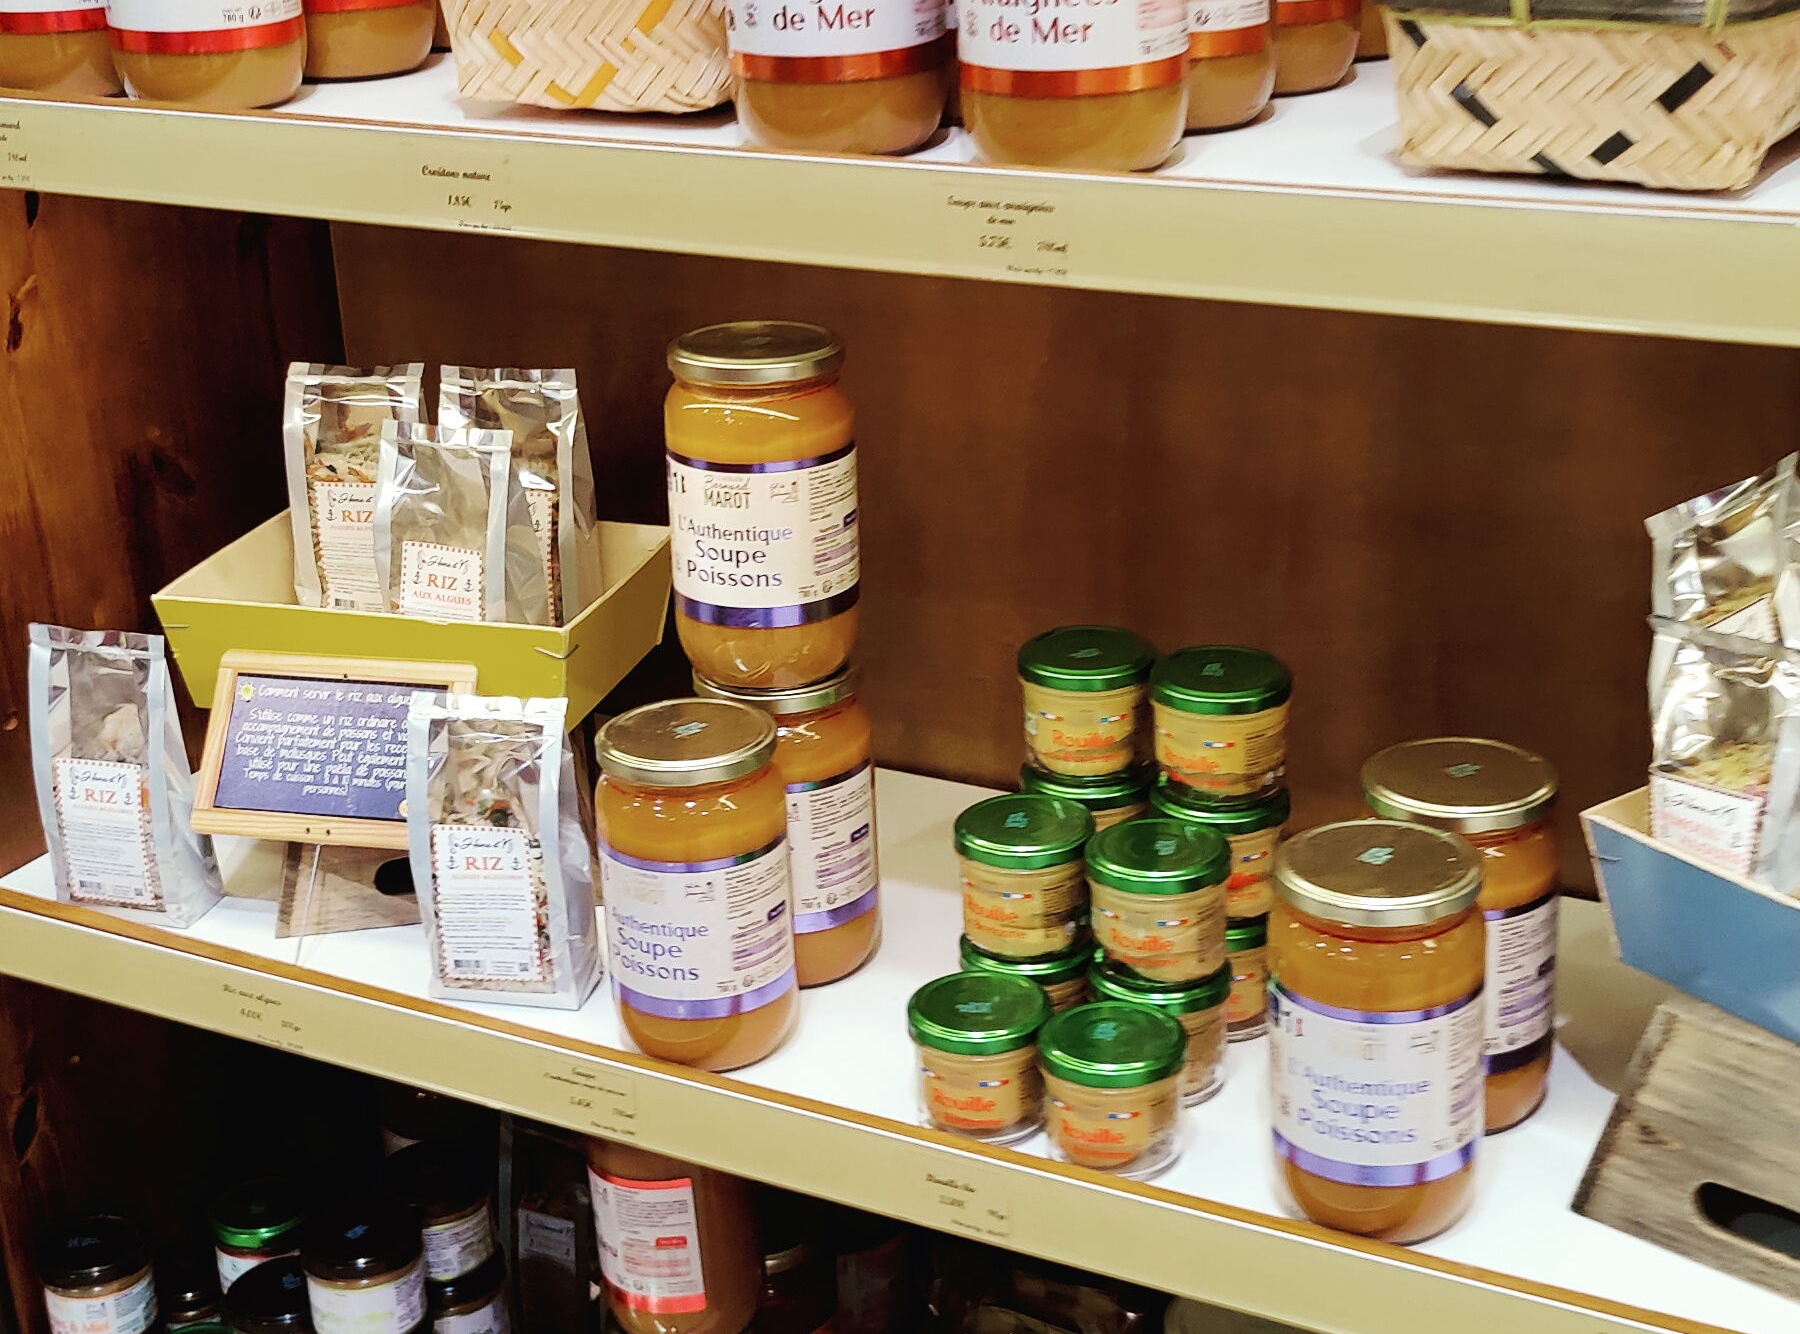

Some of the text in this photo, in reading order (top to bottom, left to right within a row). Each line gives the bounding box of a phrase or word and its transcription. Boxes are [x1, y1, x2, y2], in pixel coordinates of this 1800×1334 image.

[772, 4, 876, 31] de Mer
[989, 16, 1094, 44] de Mer
[703, 490, 752, 509] MAROT
[341, 509, 373, 524] RIZ
[677, 513, 794, 546] L'Authentique
[695, 539, 768, 568] Soupe
[427, 572, 459, 591] RIZ
[687, 559, 784, 588] Poissons
[411, 589, 473, 607] AUX ALGUES
[258, 683, 300, 699] Comment
[335, 688, 345, 701] le
[365, 692, 383, 704] aux
[387, 692, 411, 709] algue
[287, 711, 318, 725] comme
[323, 714, 335, 725] un
[242, 721, 320, 738] accompagnement
[322, 724, 335, 737] de
[382, 729, 393, 741] et
[235, 729, 276, 745] Convient
[339, 739, 362, 753] pour
[366, 741, 381, 754] les
[236, 744, 260, 757] base
[263, 746, 276, 758] de
[243, 767, 270, 782] Temps
[272, 770, 284, 782] de
[278, 761, 300, 774] pour
[303, 762, 321, 774] une
[355, 765, 368, 777] de
[371, 766, 407, 781] poisson
[84, 788, 118, 805] RIZ
[464, 855, 504, 871] RIZ
[617, 926, 684, 961] Soupe
[1311, 1088, 1401, 1124] Soupe
[1297, 1107, 1418, 1144] Poissons
